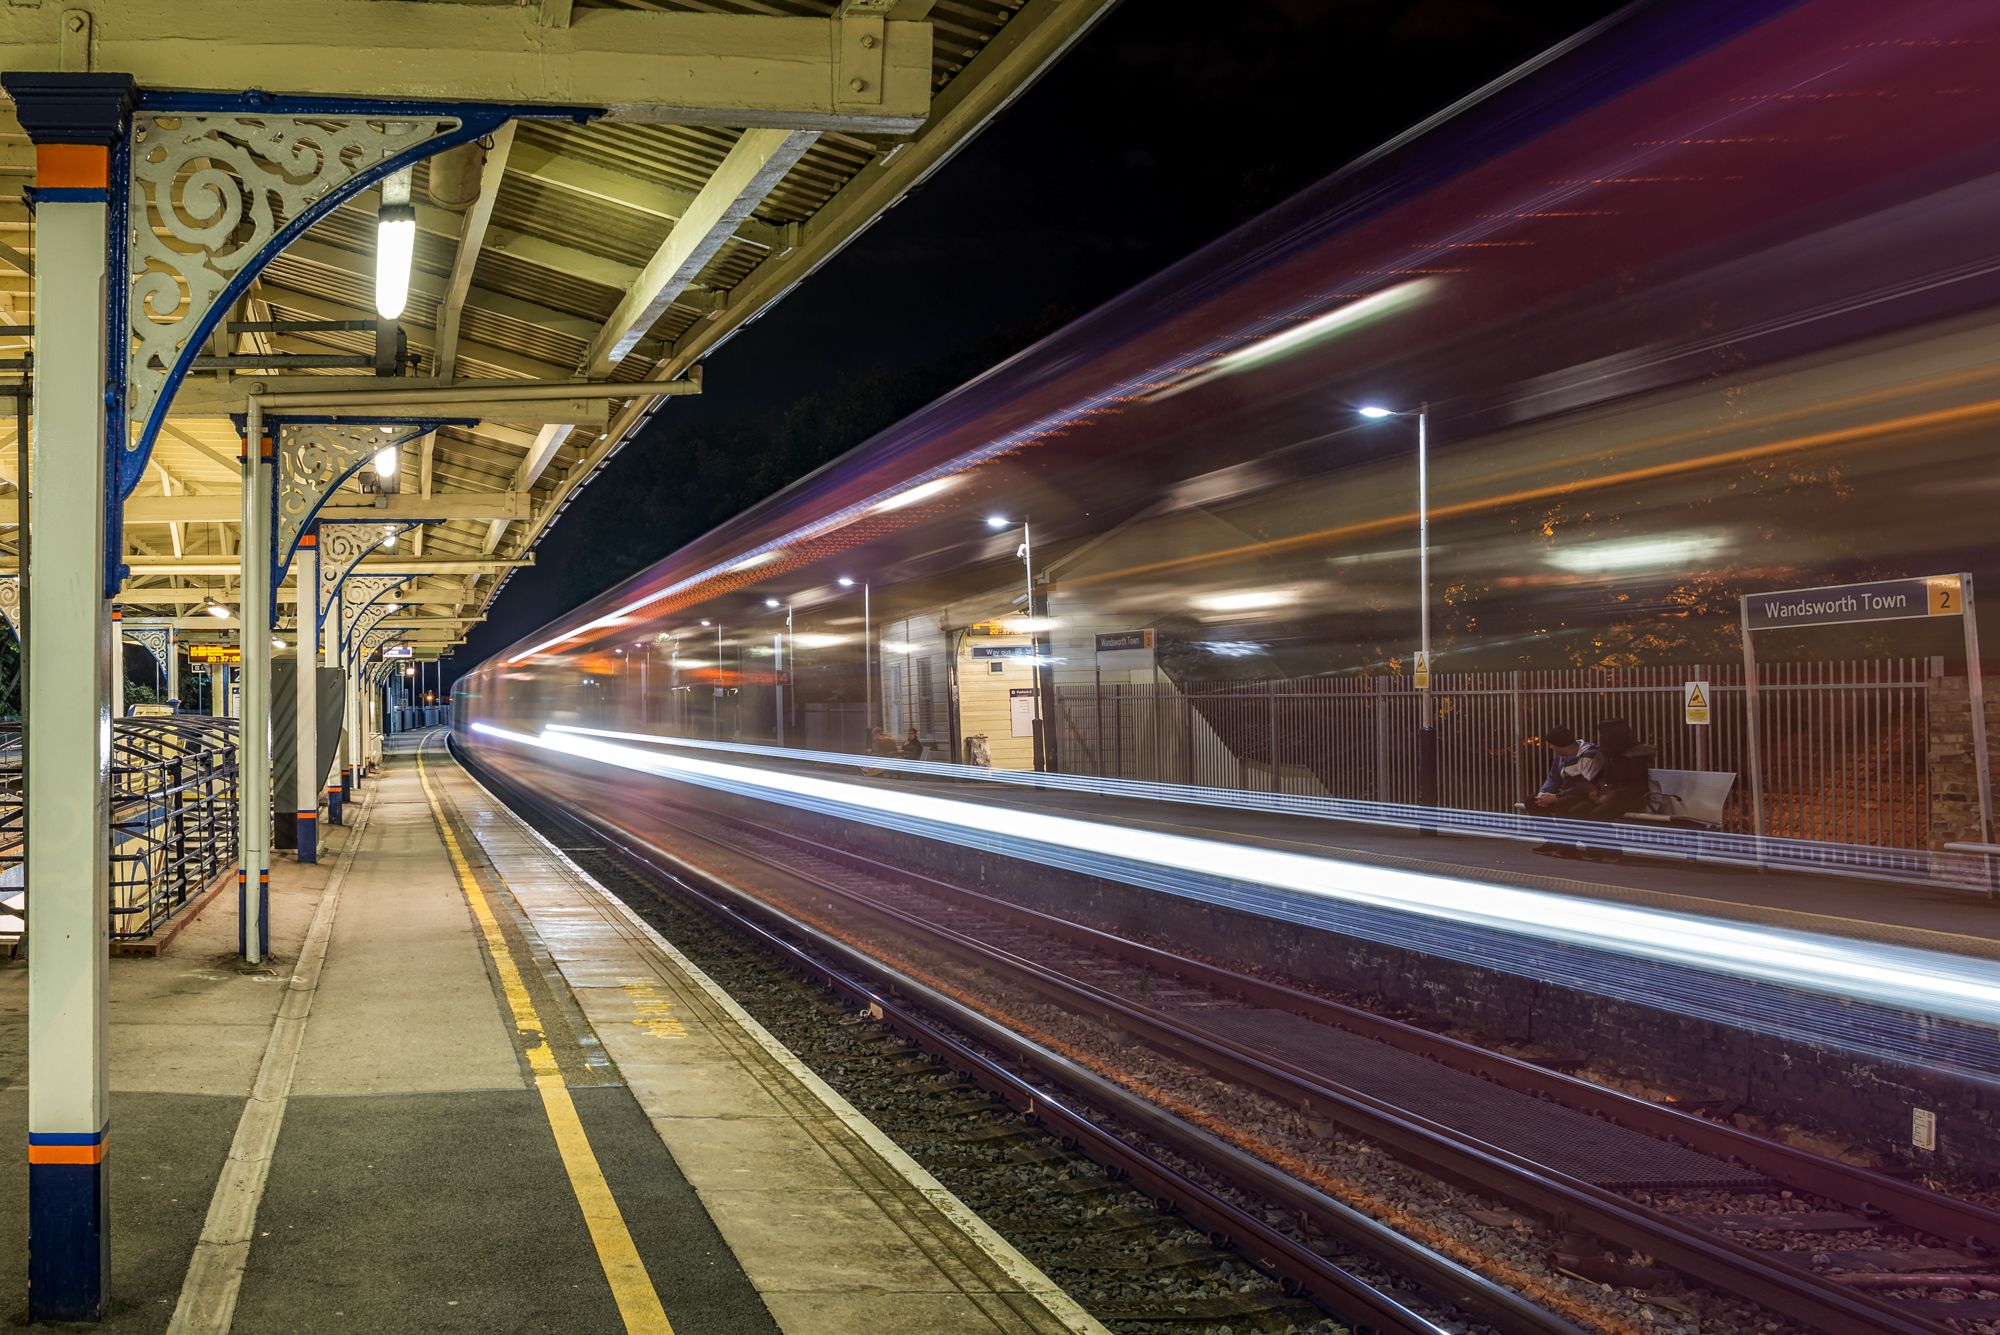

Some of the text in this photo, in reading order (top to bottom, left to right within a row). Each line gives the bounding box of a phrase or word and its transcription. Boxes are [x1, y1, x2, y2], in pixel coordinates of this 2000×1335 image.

[1765, 591, 1951, 618] Wandsworth Town 2
[1101, 637, 1127, 647] Wandsworth
[986, 648, 1000, 656] Way
